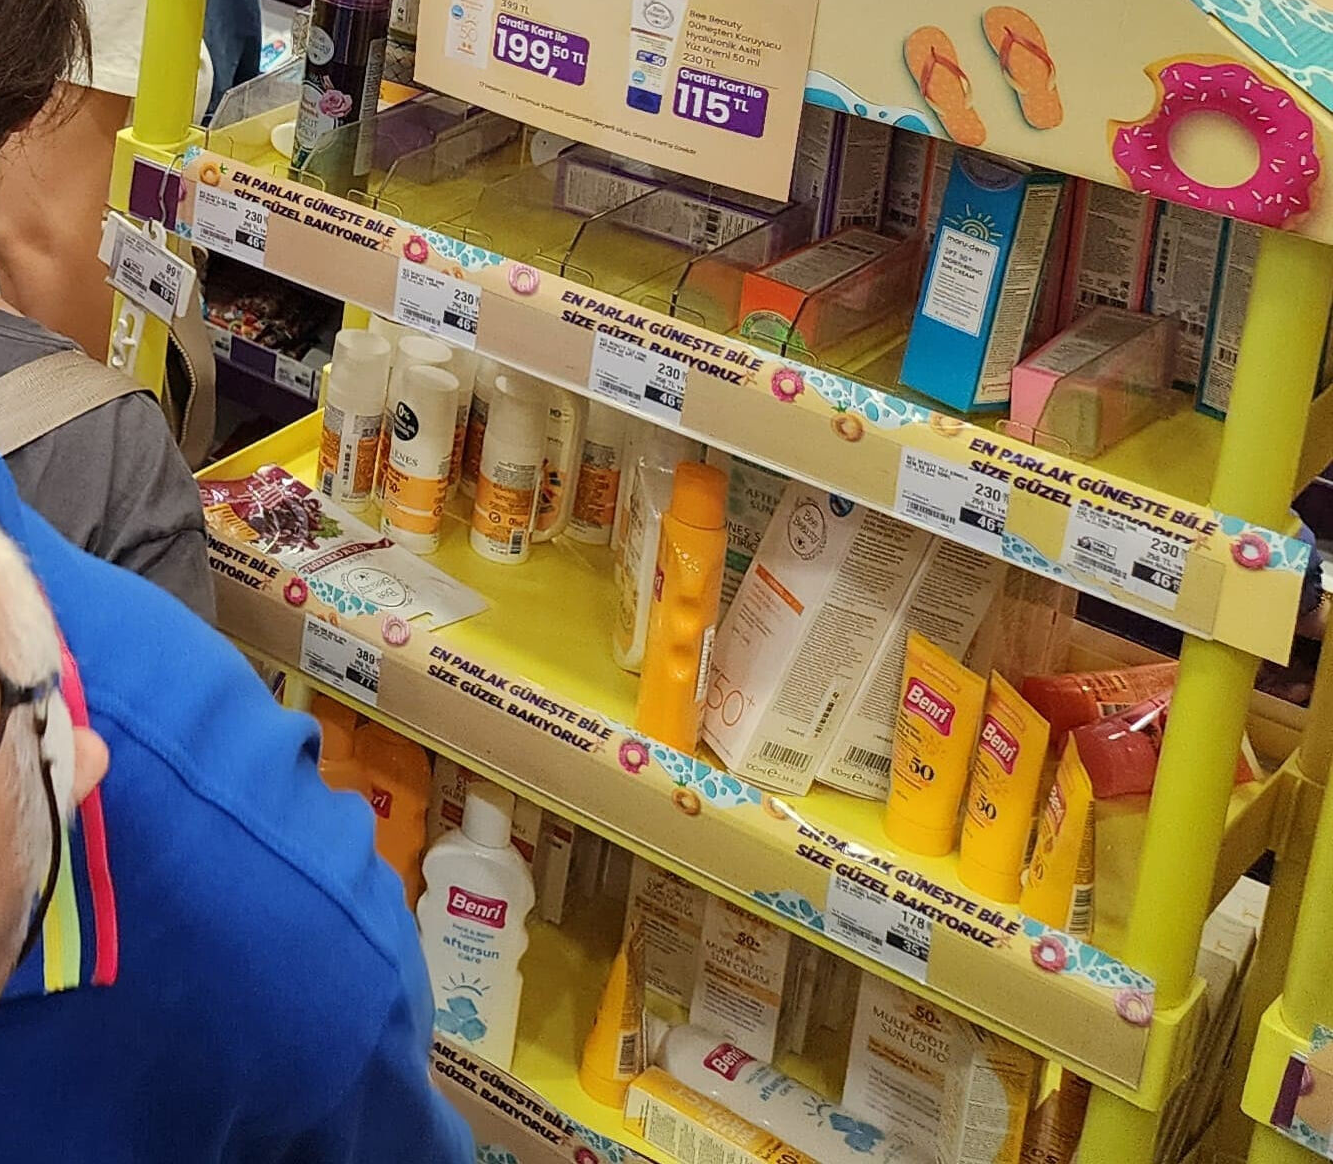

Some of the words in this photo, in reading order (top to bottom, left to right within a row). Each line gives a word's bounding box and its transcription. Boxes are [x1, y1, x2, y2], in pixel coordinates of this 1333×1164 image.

[499, 15, 530, 32] Gratis
[531, 23, 554, 40] Kart
[555, 31, 568, 43] ile
[571, 51, 585, 65] TL
[683, 53, 703, 65] 230
[705, 59, 716, 69] TL
[734, 53, 745, 63] 50
[746, 58, 760, 67] ml
[677, 83, 730, 124] 115
[734, 98, 749, 113] TL
[680, 69, 717, 87] Gratis
[718, 80, 744, 95] Kart
[745, 88, 762, 99] ile
[232, 171, 251, 186] EN
[251, 178, 304, 204] PARLAK
[304, 198, 364, 227] GÜNEŞTE
[364, 217, 397, 238] BİLE
[245, 209, 263, 224] 230
[262, 199, 302, 223] GÜZEL
[304, 215, 380, 251] BAKIYORUZ
[454, 289, 474, 305] 230
[561, 290, 586, 307] EN
[584, 298, 649, 330] PARLAK
[649, 322, 725, 358] GÜNEŞTE
[725, 346, 764, 372] BİLE
[561, 309, 598, 331] SİZE
[649, 342, 744, 386] BAKIYORUZ
[657, 362, 681, 381] 230
[968, 459, 1011, 484] SİZE
[1013, 477, 1074, 508] GÜZEL
[969, 437, 996, 456] EN
[999, 448, 1077, 486] PARLAK
[1076, 475, 1170, 520] GÜNEŞTE
[1169, 505, 1220, 536] BİLE
[974, 482, 1001, 504] 230
[207, 539, 248, 565] NEŞTE
[250, 557, 280, 579] BİLE
[1150, 537, 1180, 559] 230
[209, 556, 263, 589] KIYORUZ
[427, 664, 460, 687] SİZE
[459, 680, 505, 710] GÜZEL
[506, 703, 595, 752] BAKIYORUZ
[429, 645, 451, 663] EN
[450, 656, 509, 690] PARLAK
[509, 684, 580, 724] GÜNEŞTE
[577, 716, 614, 741] BİLE
[906, 684, 950, 724] Benri
[982, 721, 1017, 762] Benri
[909, 757, 935, 781] 50
[451, 893, 503, 920] Benri
[796, 844, 834, 869] SİZE
[835, 865, 890, 897] GÜZEL
[893, 891, 998, 948] BAKIYORUZ
[895, 872, 978, 915] GÜNEŞTE
[977, 905, 1021, 936] BİLE
[901, 910, 926, 930] 178
[443, 935, 499, 959] aftersun
[433, 1041, 479, 1075] ARLAK
[480, 1069, 544, 1116] GÜNEŞTE
[543, 1110, 575, 1136] BİLE
[435, 1060, 478, 1095] GÜZEL
[480, 1088, 560, 1145] BAKIYORUZ
